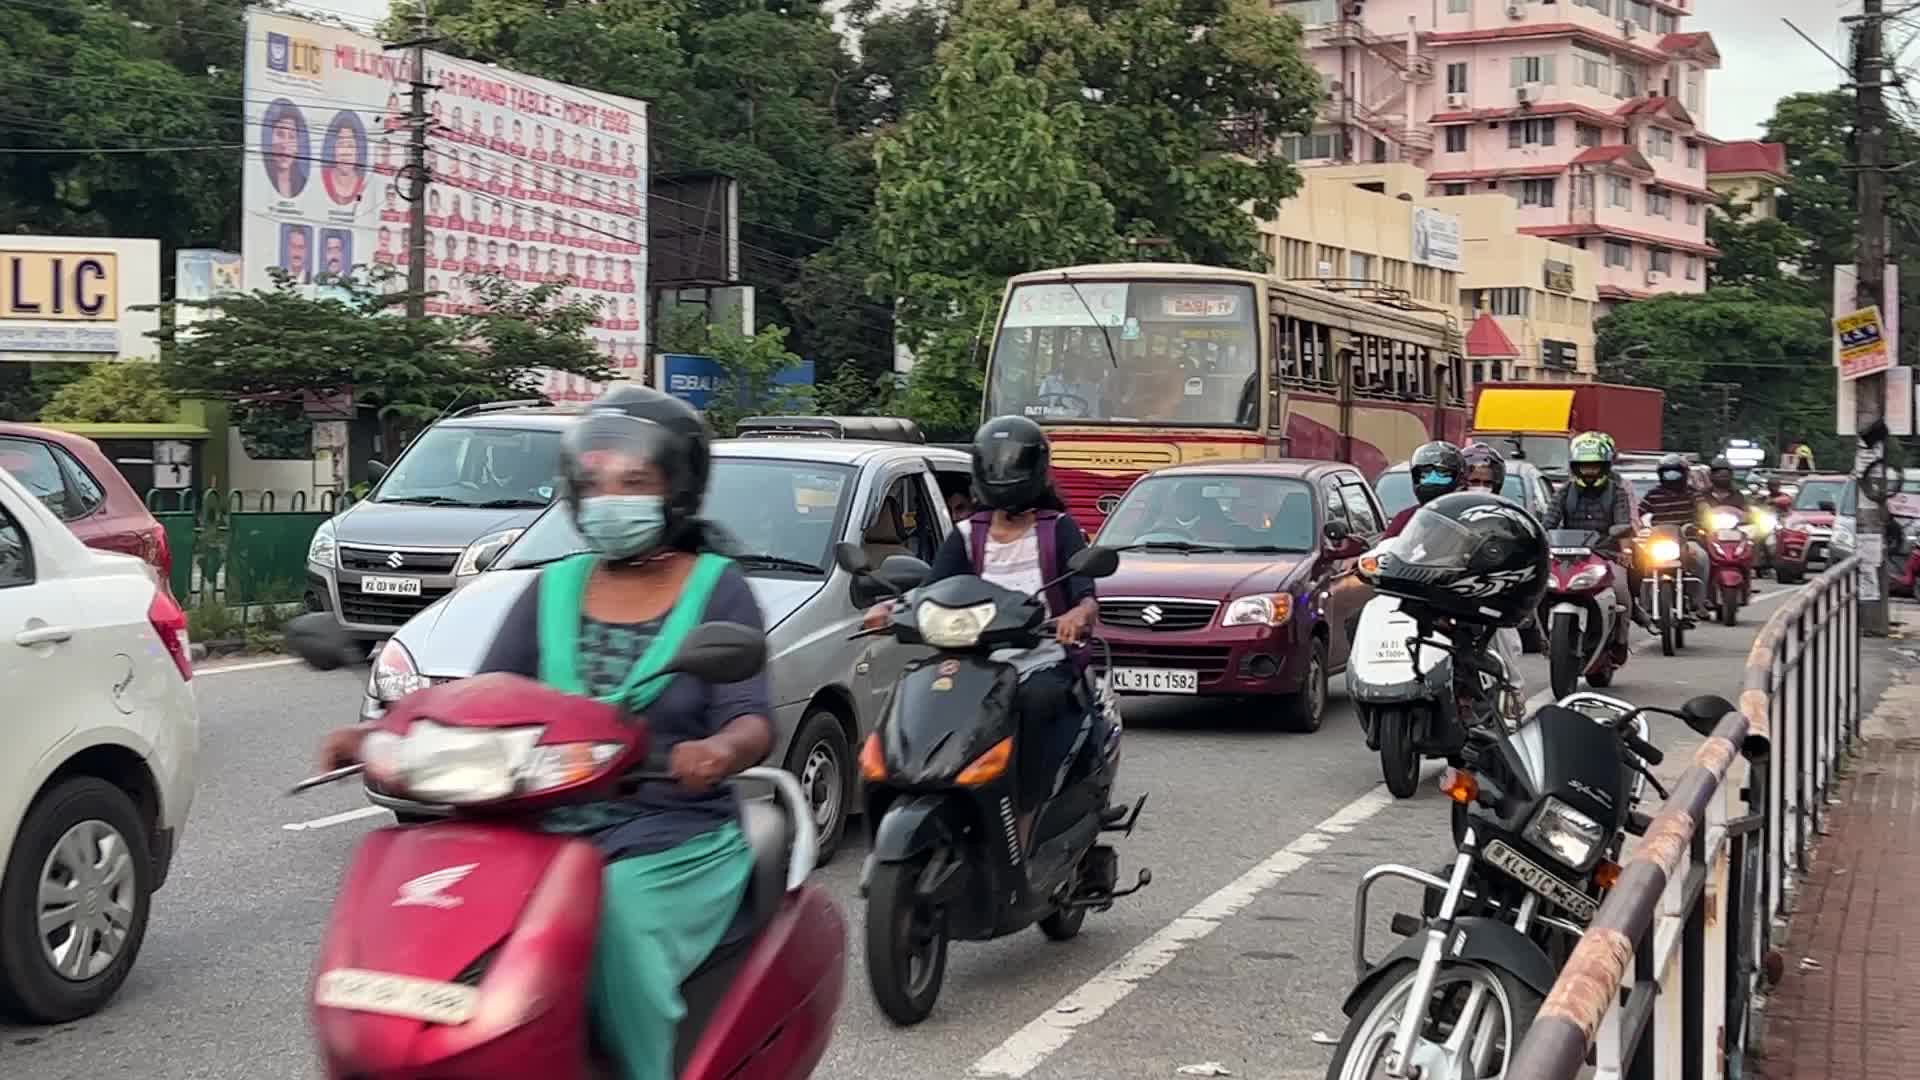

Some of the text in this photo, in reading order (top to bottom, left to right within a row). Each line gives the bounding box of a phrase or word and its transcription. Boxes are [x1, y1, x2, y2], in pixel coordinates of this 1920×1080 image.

[293, 41, 321, 74] LIC
[511, 87, 552, 116] TABLE
[11, 257, 105, 315] LIC
[1115, 672, 1195, 689] KL 31 C 1582
